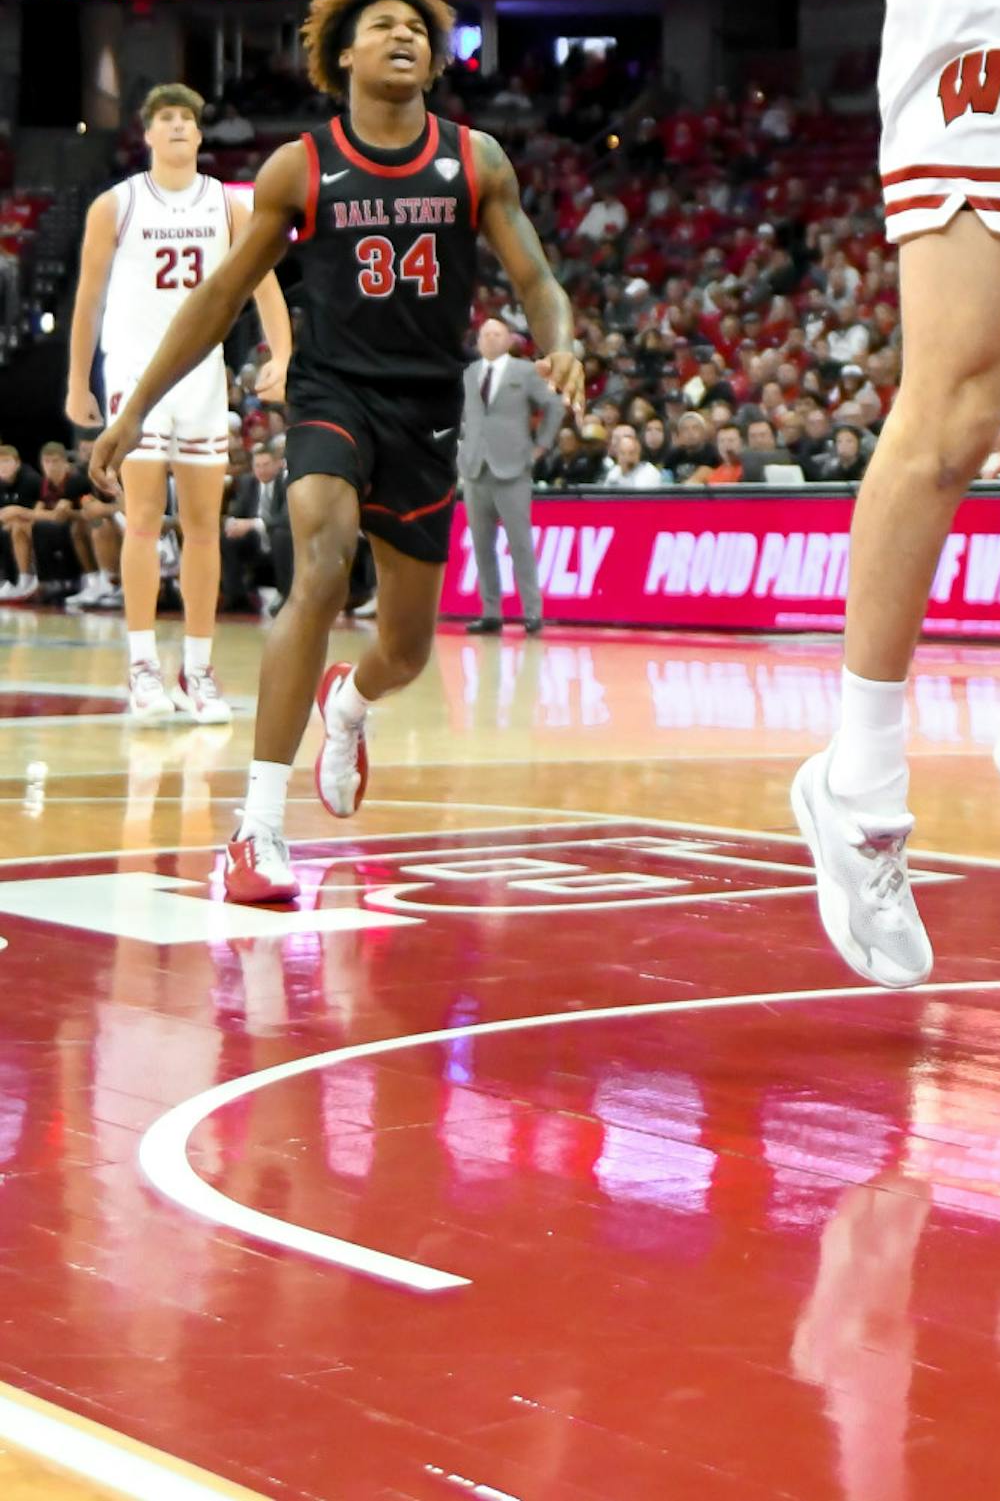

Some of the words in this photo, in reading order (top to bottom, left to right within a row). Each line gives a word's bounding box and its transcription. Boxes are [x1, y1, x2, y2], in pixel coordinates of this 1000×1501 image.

[142, 226, 217, 240] WISCONSIN
[334, 200, 389, 228] BALL
[395, 197, 457, 224] STATE
[155, 246, 204, 289] 23
[355, 233, 440, 297] 34
[645, 531, 758, 595] PROUD
[753, 532, 850, 598] PART
